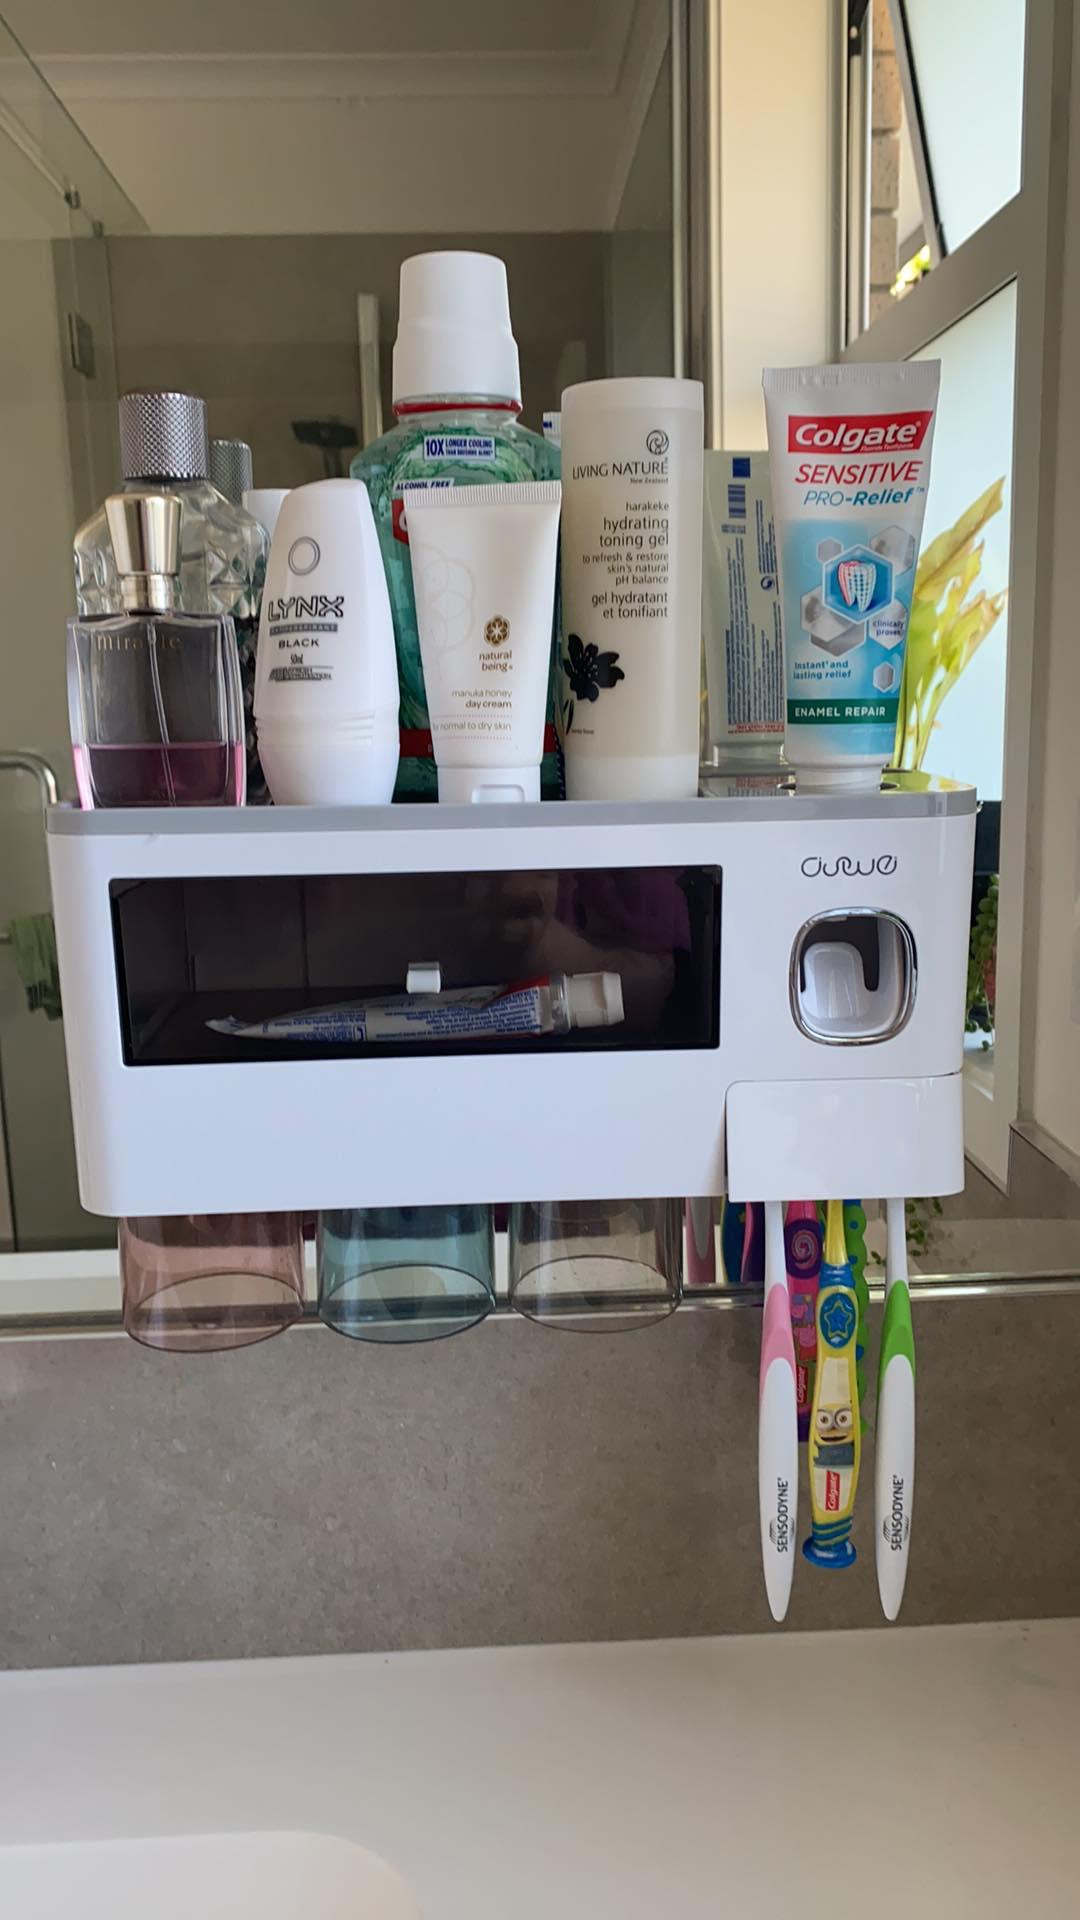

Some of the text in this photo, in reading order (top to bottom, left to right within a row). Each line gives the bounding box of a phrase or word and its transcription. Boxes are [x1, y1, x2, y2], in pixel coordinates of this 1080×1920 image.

[795, 423, 918, 452] Colgate
[426, 438, 492, 456] 10X LONGER COOLING
[572, 460, 669, 480] LIVING NATURE
[795, 460, 923, 484] SENSITIVE
[395, 479, 450, 491] ALCOHOL FREE
[625, 501, 669, 511] harakeke
[603, 515, 669, 534] hydrating
[599, 530, 669, 549] toning gel
[582, 552, 669, 564] to refresh & restore
[607, 563, 669, 574] skin's natural
[615, 574, 669, 586] pH balance
[591, 591, 668, 607] gel hydratant
[268, 595, 344, 621] LYNX
[602, 605, 668, 618] et tonifiant
[278, 638, 320, 649] BLACK
[478, 650, 512, 661] natural
[830, 660, 849, 669] and
[793, 669, 852, 680] lasting relief
[451, 689, 512, 699] manuka honey
[465, 700, 512, 709] day cream
[794, 705, 886, 717] ENAMEL REPAIR
[467, 721, 477, 730] to
[477, 721, 493, 731] dry
[493, 721, 512, 731] skin
[827, 1472, 840, 1510] Colgate
[776, 1478, 789, 1553] SENSODYNE
[891, 1477, 904, 1551] SENSODYNE
